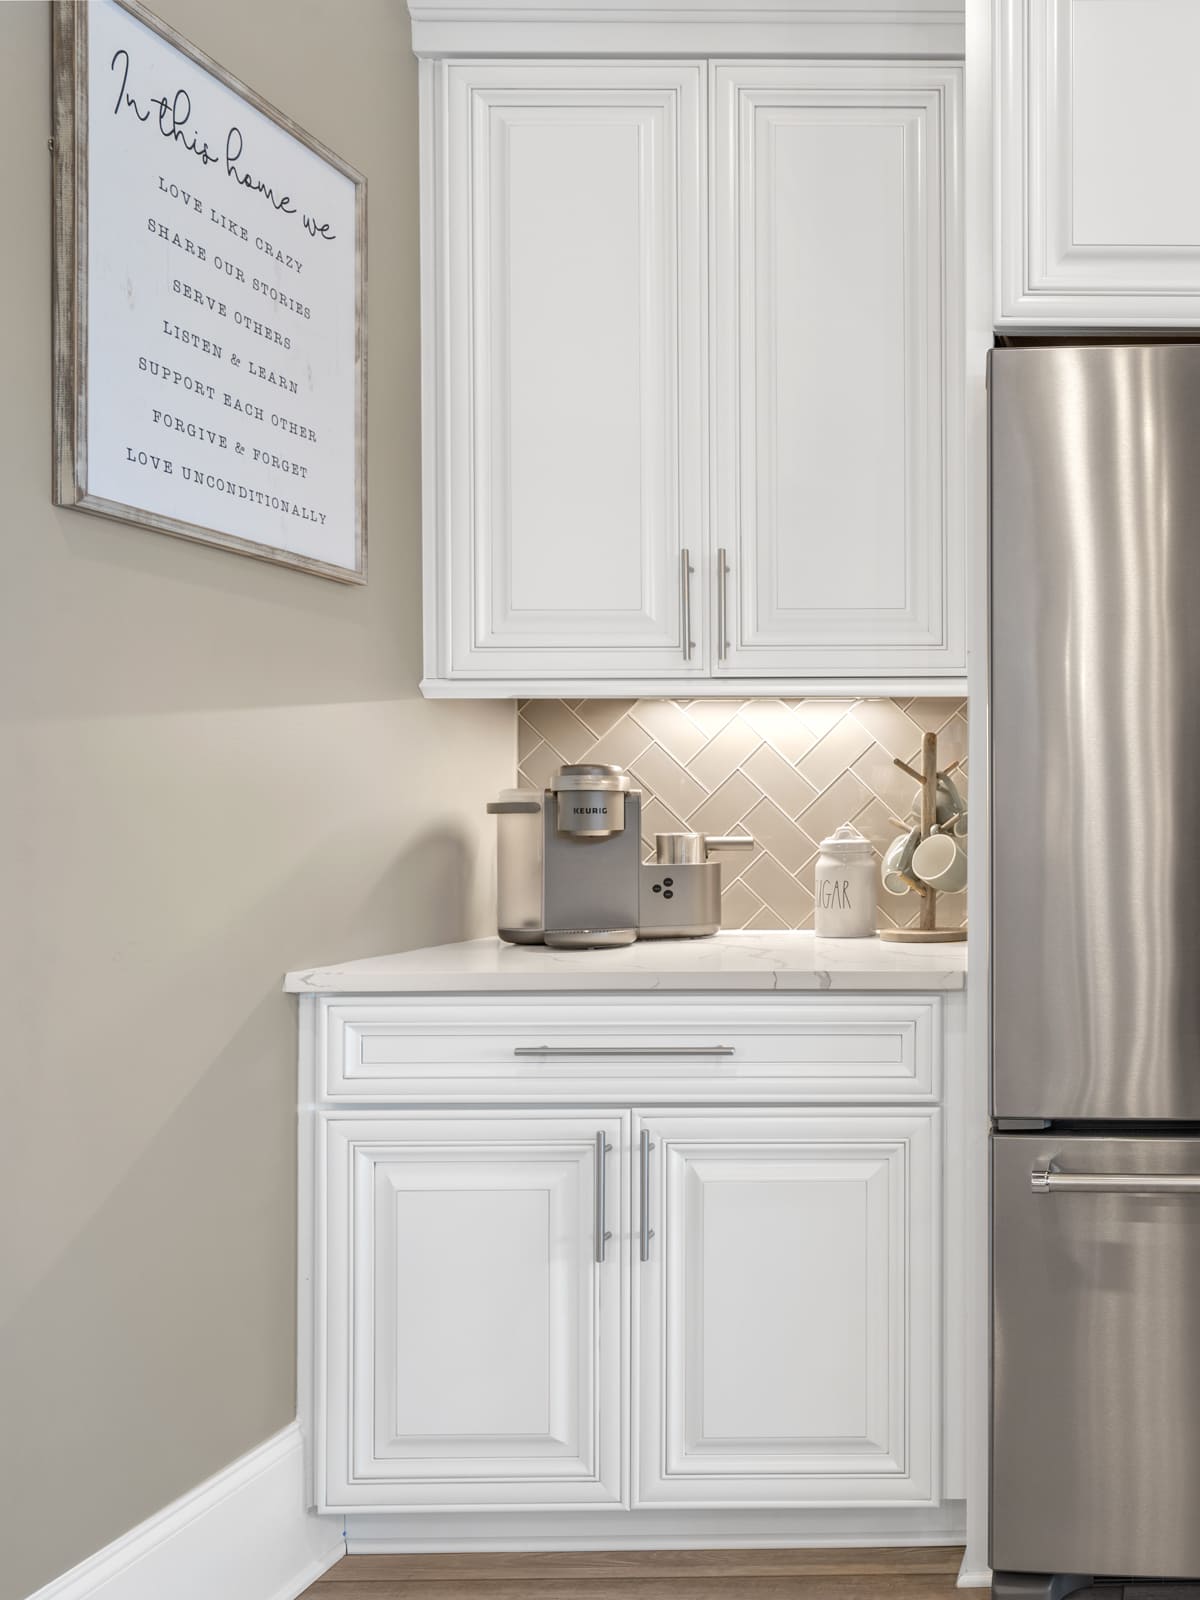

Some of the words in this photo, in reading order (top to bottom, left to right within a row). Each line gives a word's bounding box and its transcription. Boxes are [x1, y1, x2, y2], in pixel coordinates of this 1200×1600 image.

[110, 49, 150, 122] In
[150, 89, 219, 165] this
[226, 127, 297, 214] home
[303, 213, 336, 241] we
[158, 175, 203, 214] LOVE
[210, 208, 249, 242] LIKE
[255, 236, 304, 275] CRAZY
[147, 217, 207, 262] SHARE
[213, 255, 246, 284] OUR
[252, 277, 312, 320] STORIES
[172, 279, 227, 318] SERVE
[233, 311, 291, 351] OTHERS
[162, 319, 223, 359] LISTEN
[230, 352, 241, 368] &
[248, 361, 298, 395] LEARN
[138, 356, 216, 401] SUPPORT
[223, 392, 265, 422] EACH
[271, 413, 318, 443] OTHER
[151, 408, 228, 449] FORGIVE
[234, 441, 246, 456] &
[252, 447, 308, 479] FORGET
[125, 447, 173, 475] LOVE
[181, 465, 327, 525] UNCONDITIONALLY
[573, 807, 608, 815] KEURIG
[816, 879, 852, 909] UGAR
